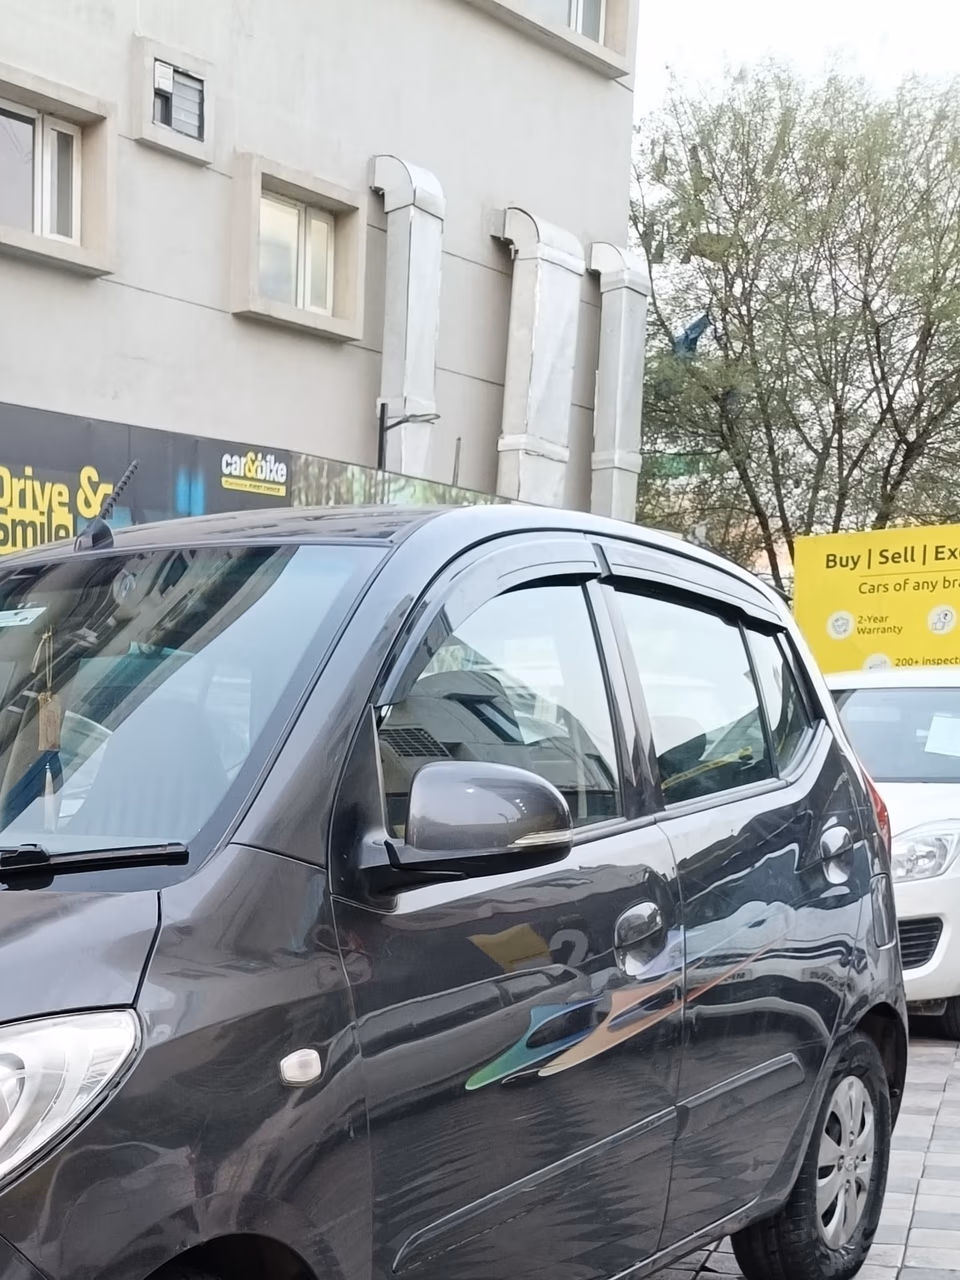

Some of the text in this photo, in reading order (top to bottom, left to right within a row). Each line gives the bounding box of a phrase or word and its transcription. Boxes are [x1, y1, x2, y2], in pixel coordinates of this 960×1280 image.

[222, 451, 287, 483] car&bike
[76, 466, 114, 519] &
[825, 553, 860, 570] Buy
[878, 546, 915, 565] Sell
[934, 545, 960, 561] Ex
[858, 576, 960, 594] Cars of any br
[857, 615, 889, 624] 2-Year
[857, 625, 903, 635] Warranty
[895, 655, 960, 667] 200+ inspect
